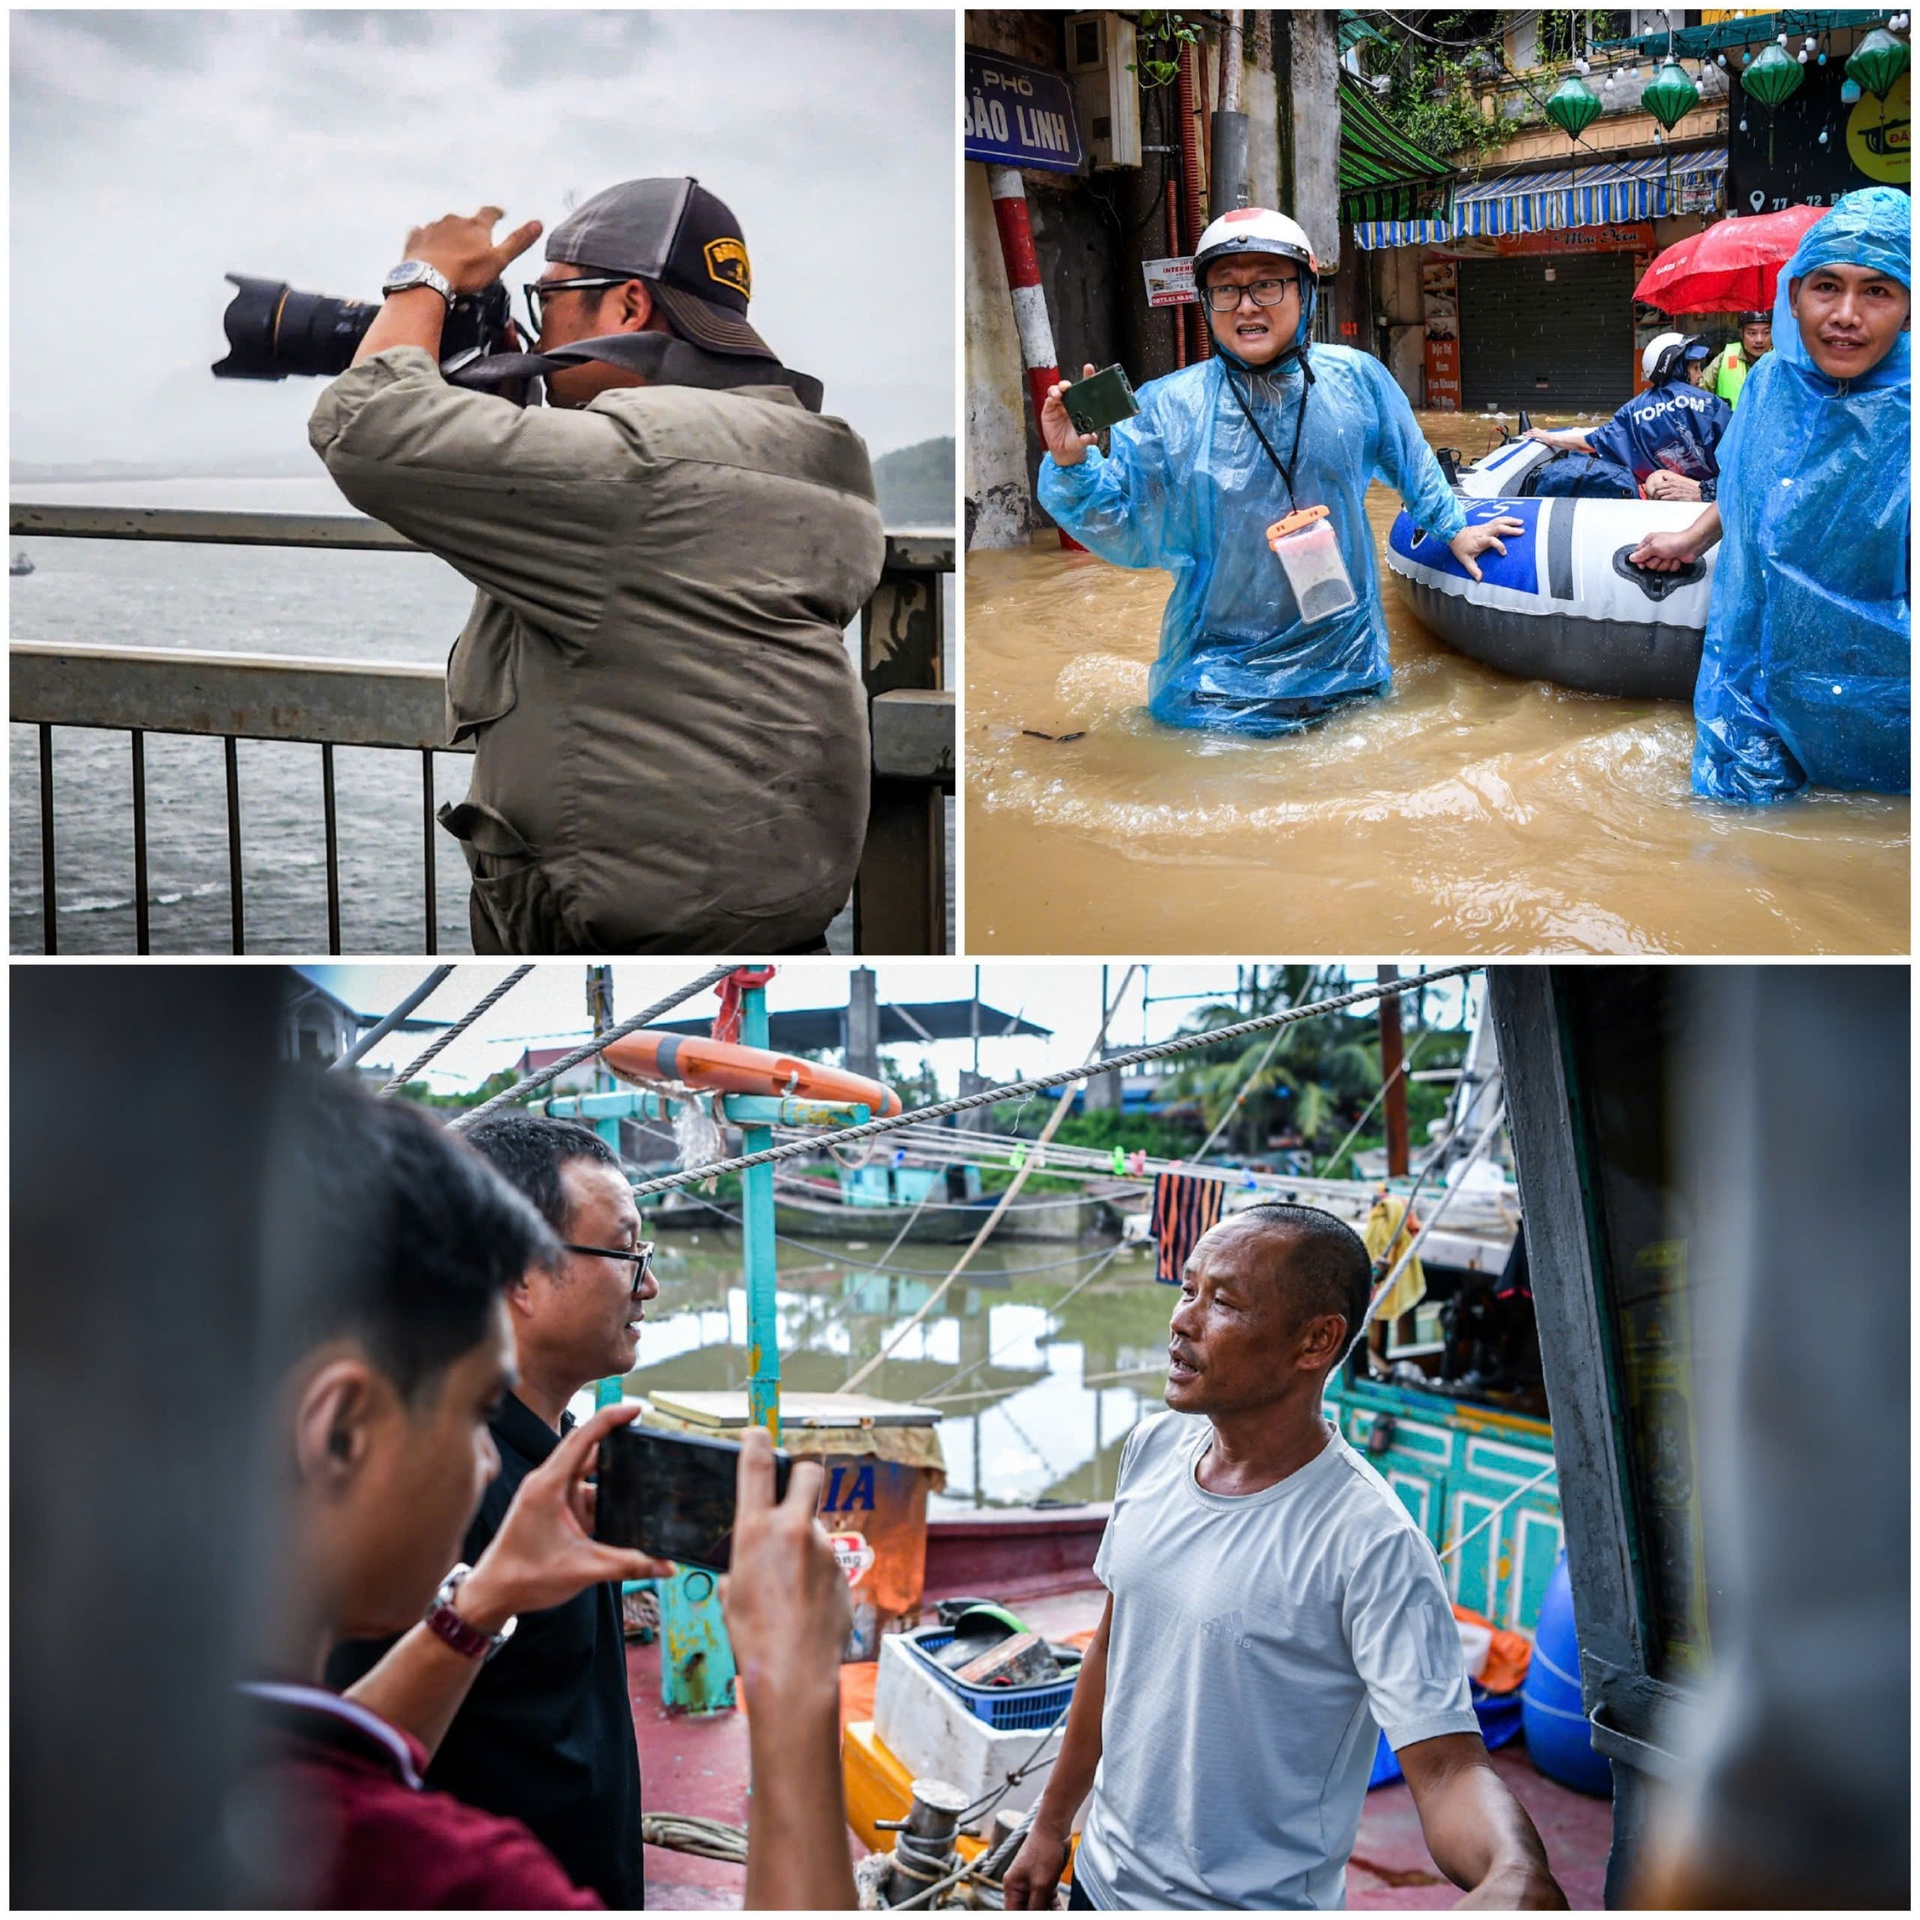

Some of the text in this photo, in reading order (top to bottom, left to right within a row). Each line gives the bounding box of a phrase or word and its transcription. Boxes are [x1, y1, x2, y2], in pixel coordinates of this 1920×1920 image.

[1016, 105, 1070, 153] LINH
[1772, 197, 1788, 211] 77
[1806, 195, 1822, 207] 72
